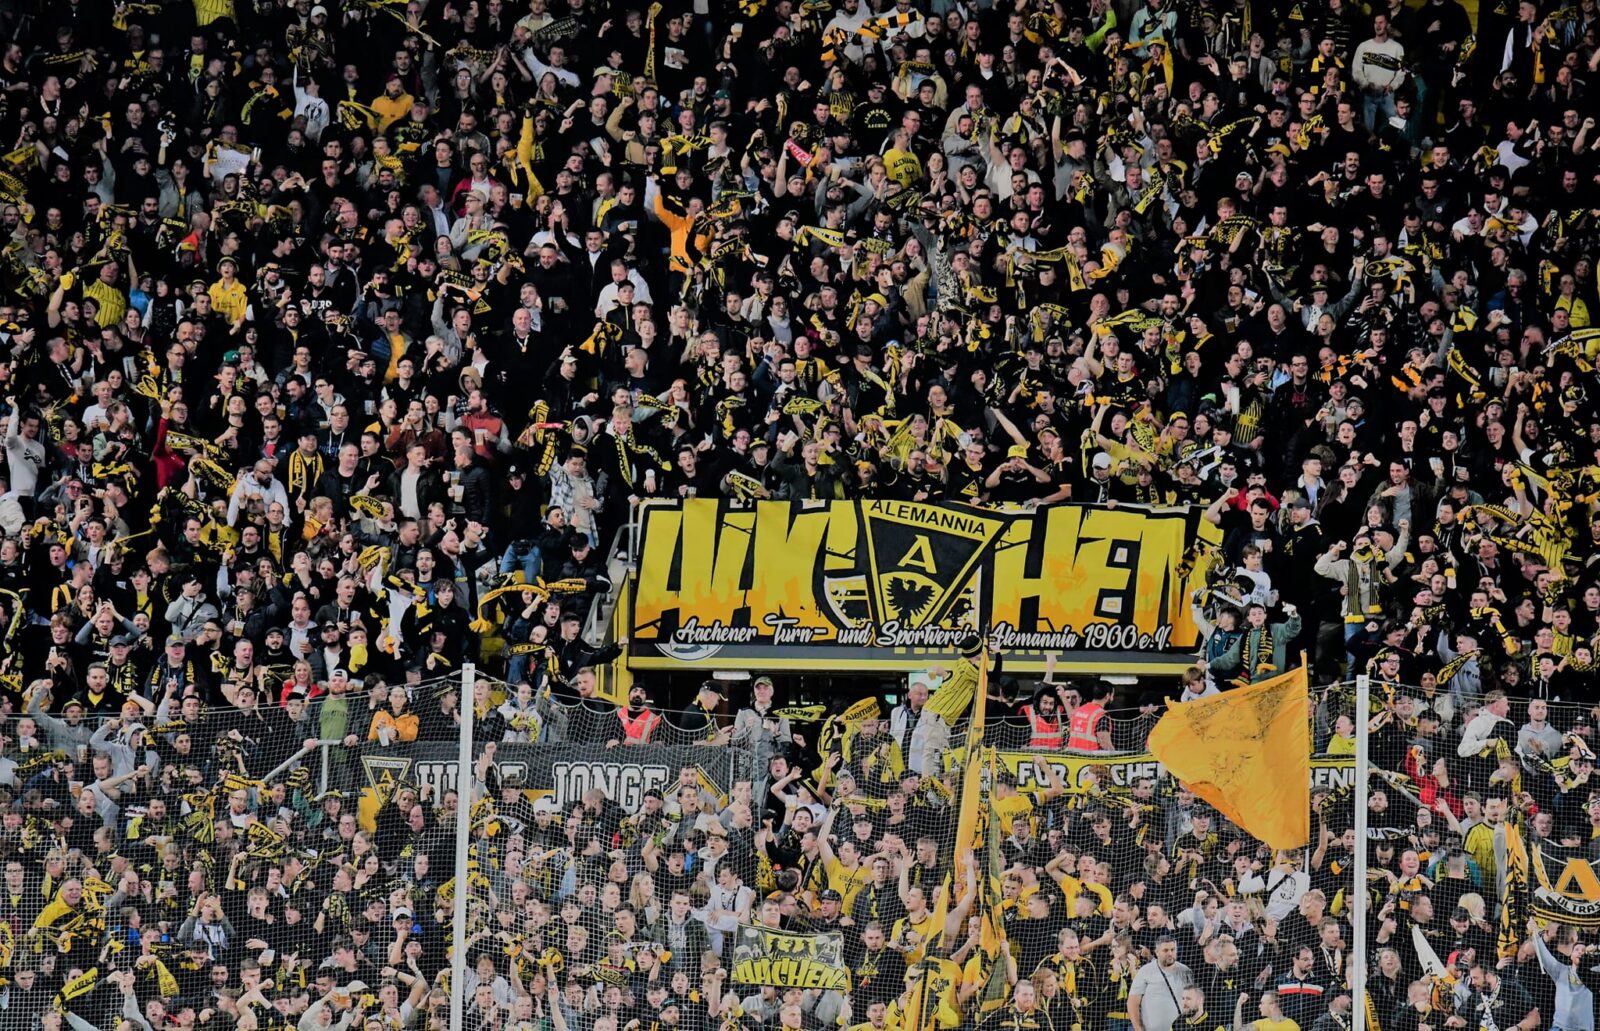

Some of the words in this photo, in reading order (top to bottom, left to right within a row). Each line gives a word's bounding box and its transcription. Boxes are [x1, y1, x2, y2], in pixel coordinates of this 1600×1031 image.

[870, 500, 986, 537] ALEMANNIA
[897, 534, 938, 575] A
[676, 618, 758, 643] Aachener
[764, 615, 828, 645] Turn-
[837, 621, 872, 644] und
[989, 622, 1079, 649] Alemannia
[1084, 624, 1137, 649] 1900
[736, 957, 845, 989] AACHEN
